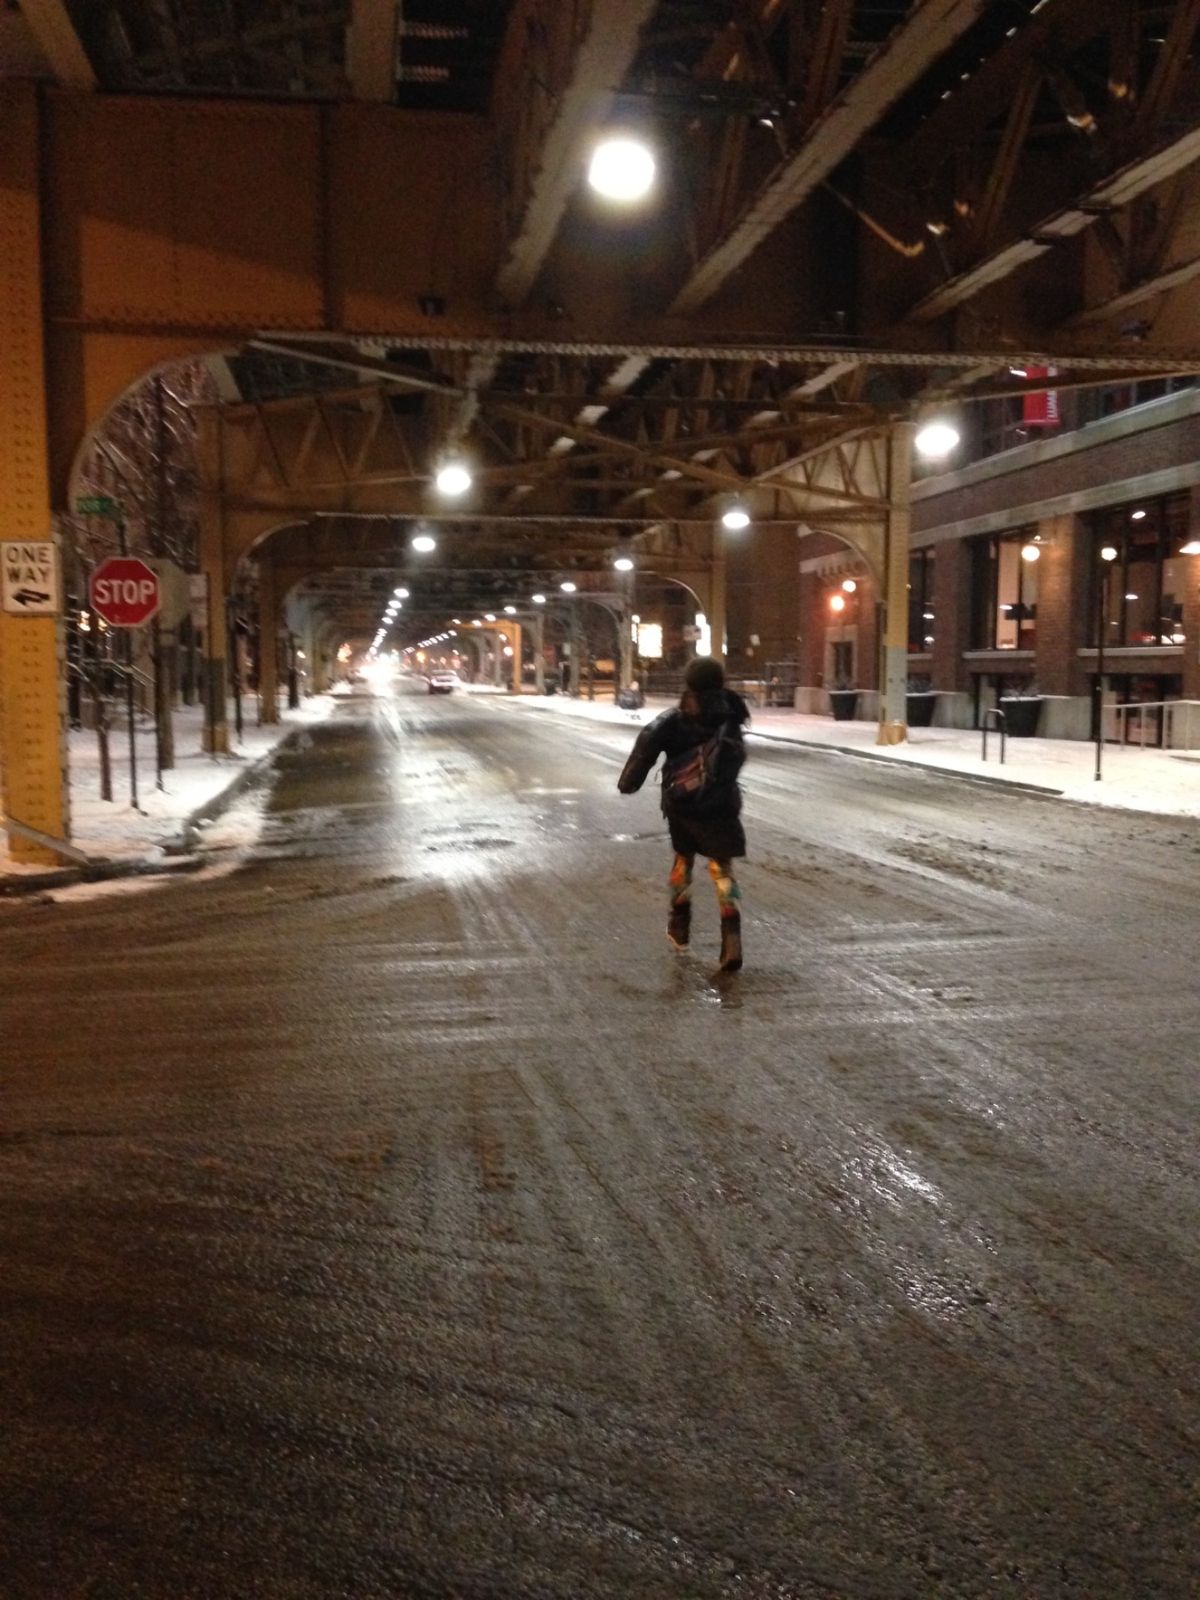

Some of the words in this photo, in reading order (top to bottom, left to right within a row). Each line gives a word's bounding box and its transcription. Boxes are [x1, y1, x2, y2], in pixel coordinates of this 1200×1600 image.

[6, 545, 51, 564] ONE
[6, 566, 50, 584] WAY
[95, 579, 155, 605] STOP
